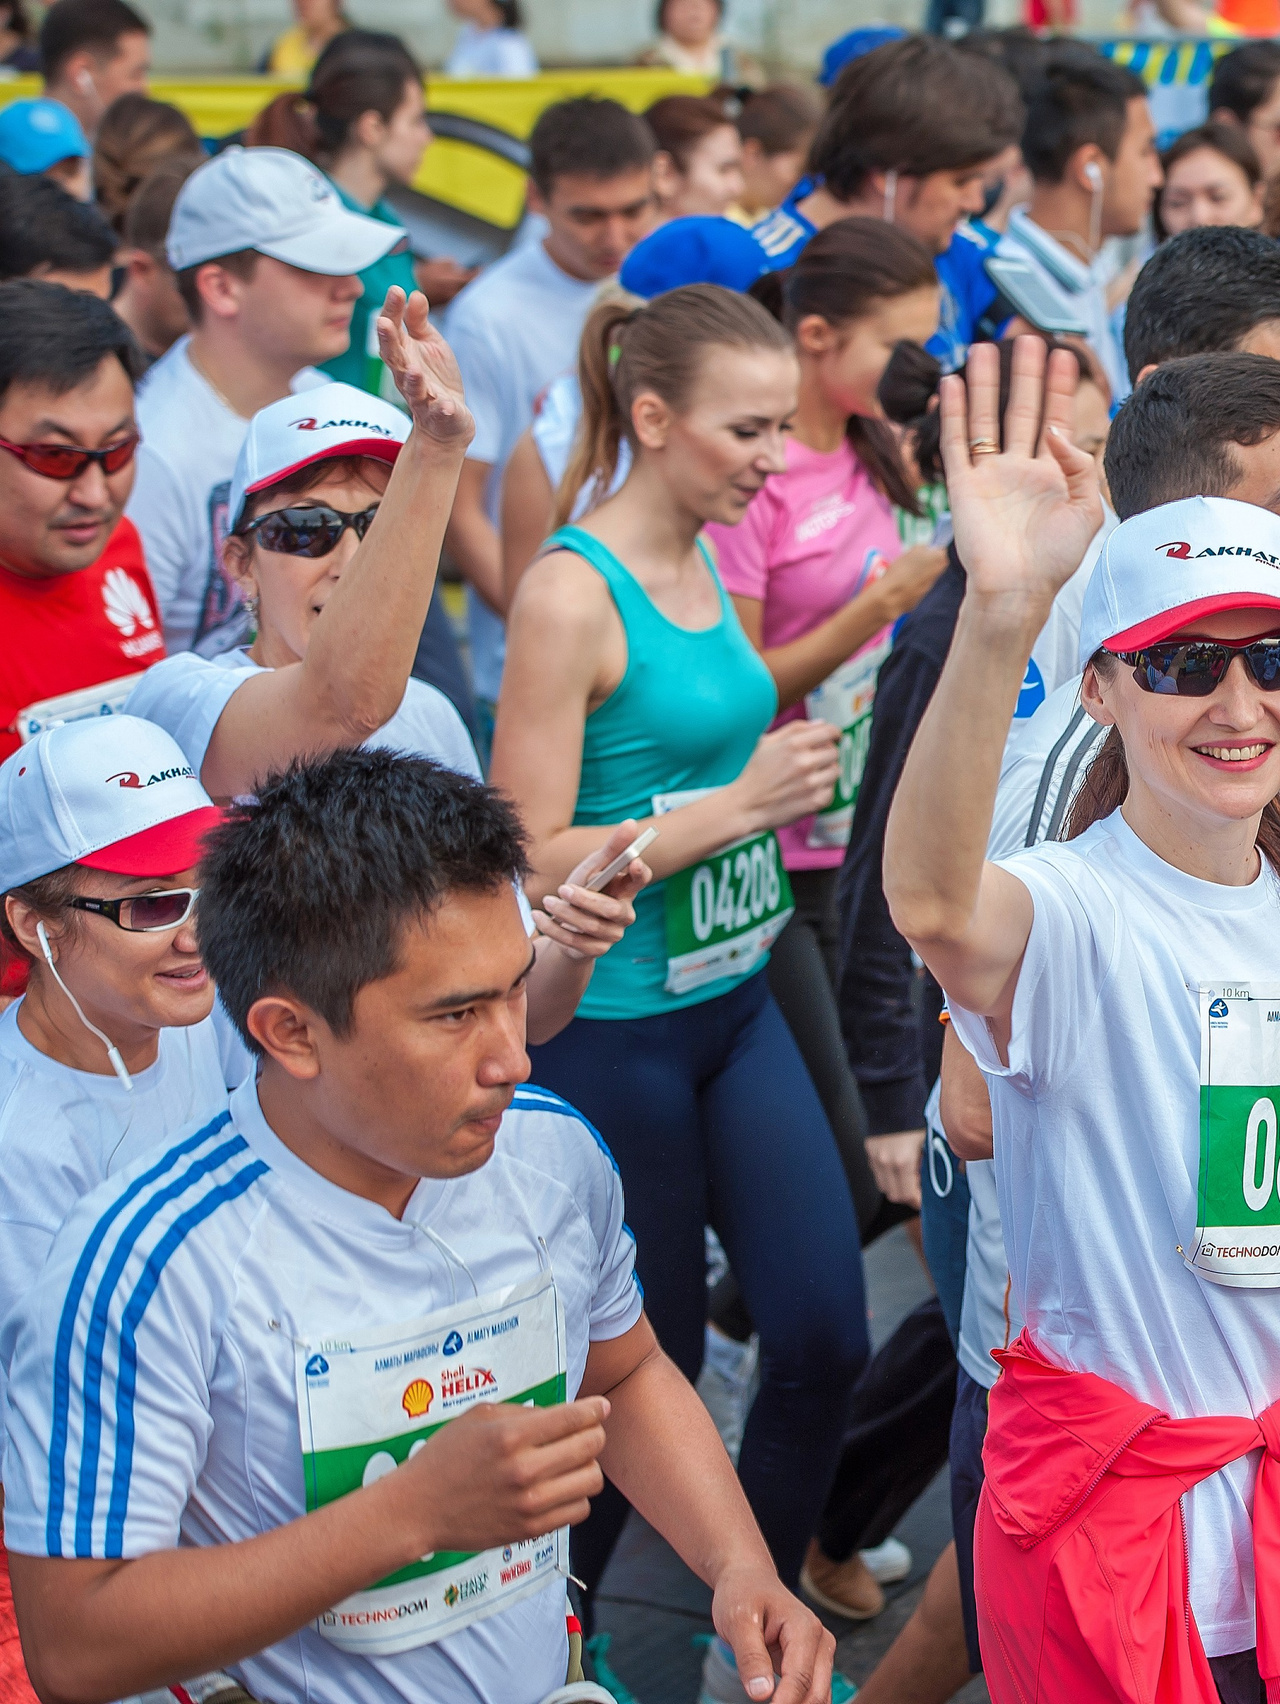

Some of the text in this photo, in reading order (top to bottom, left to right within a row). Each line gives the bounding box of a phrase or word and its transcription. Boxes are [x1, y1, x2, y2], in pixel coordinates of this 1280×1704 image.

[1222, 988, 1250, 998] 10 km
[467, 1319, 520, 1344] ALMATY MARATHON
[441, 1364, 465, 1380] Shell
[441, 1368, 496, 1399] HELIX
[340, 1598, 429, 1627] TECHNODOM
